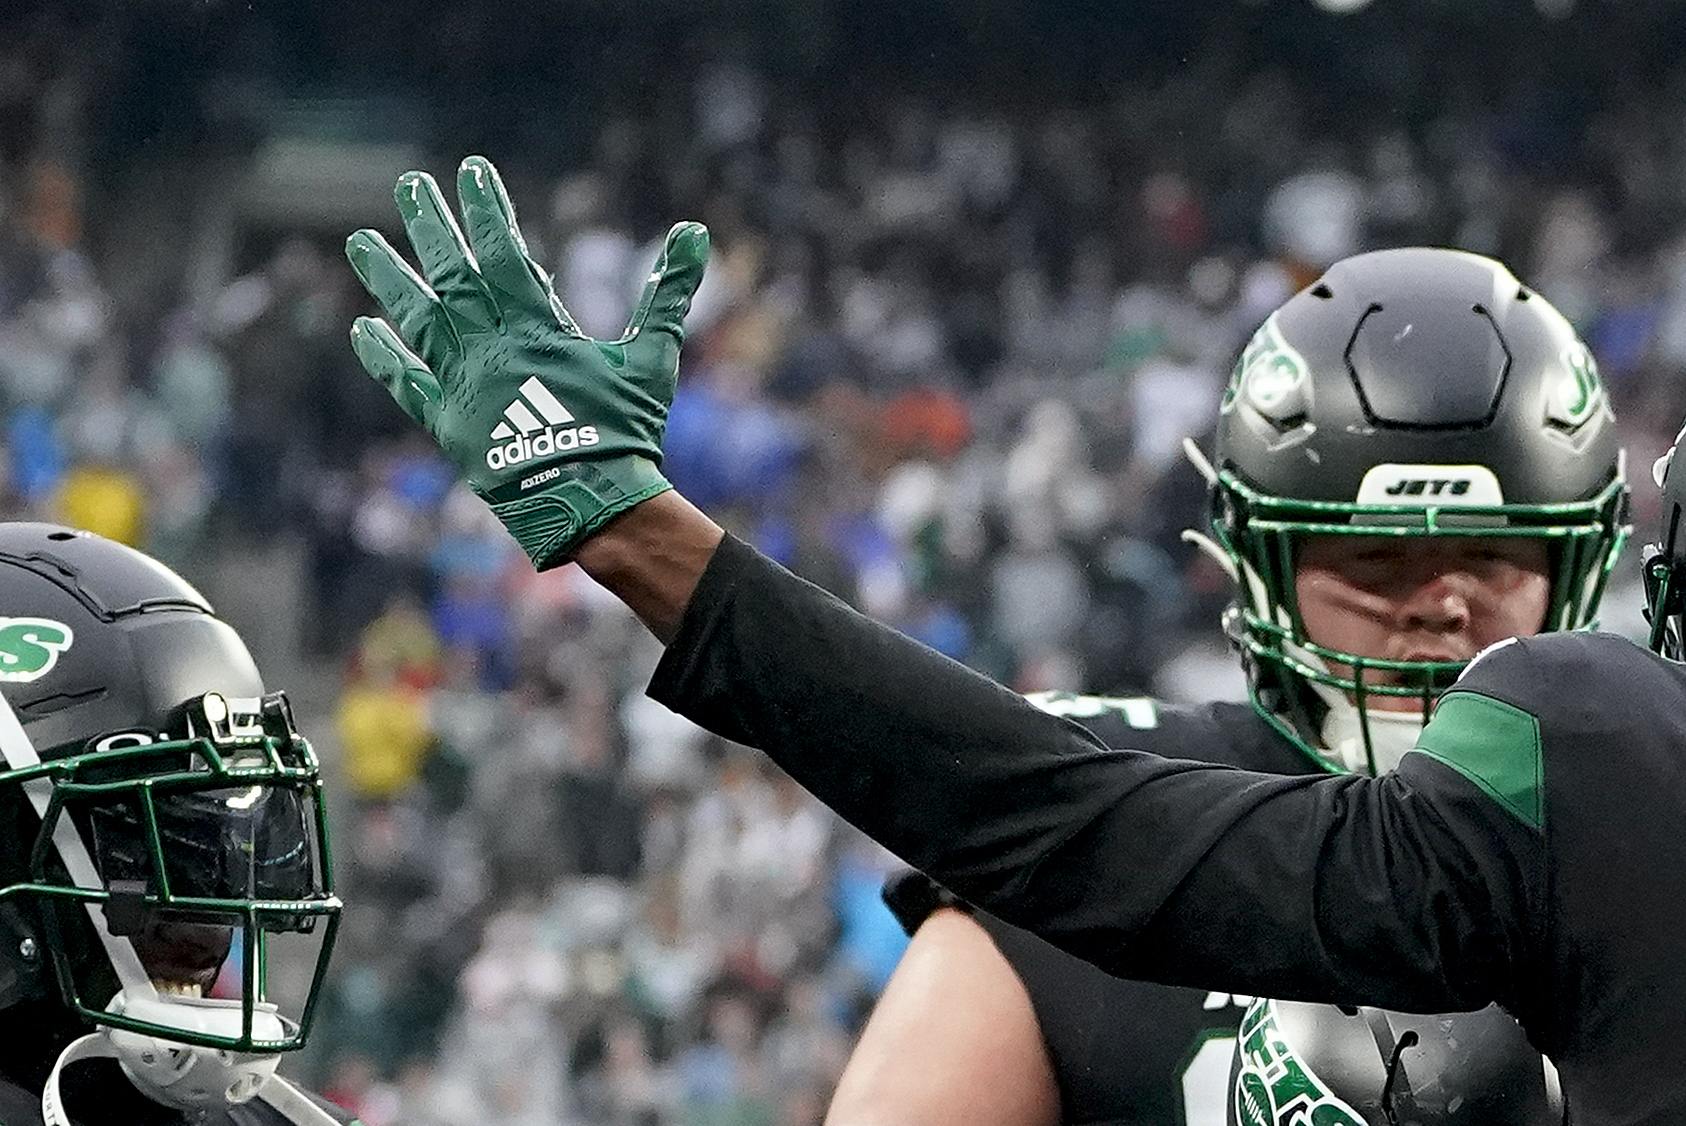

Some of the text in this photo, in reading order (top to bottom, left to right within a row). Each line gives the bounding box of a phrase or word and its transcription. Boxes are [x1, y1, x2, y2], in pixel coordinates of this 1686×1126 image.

[486, 426, 599, 470] adidas
[520, 467, 560, 490] ADIZERO
[1385, 480, 1470, 496] JETS
